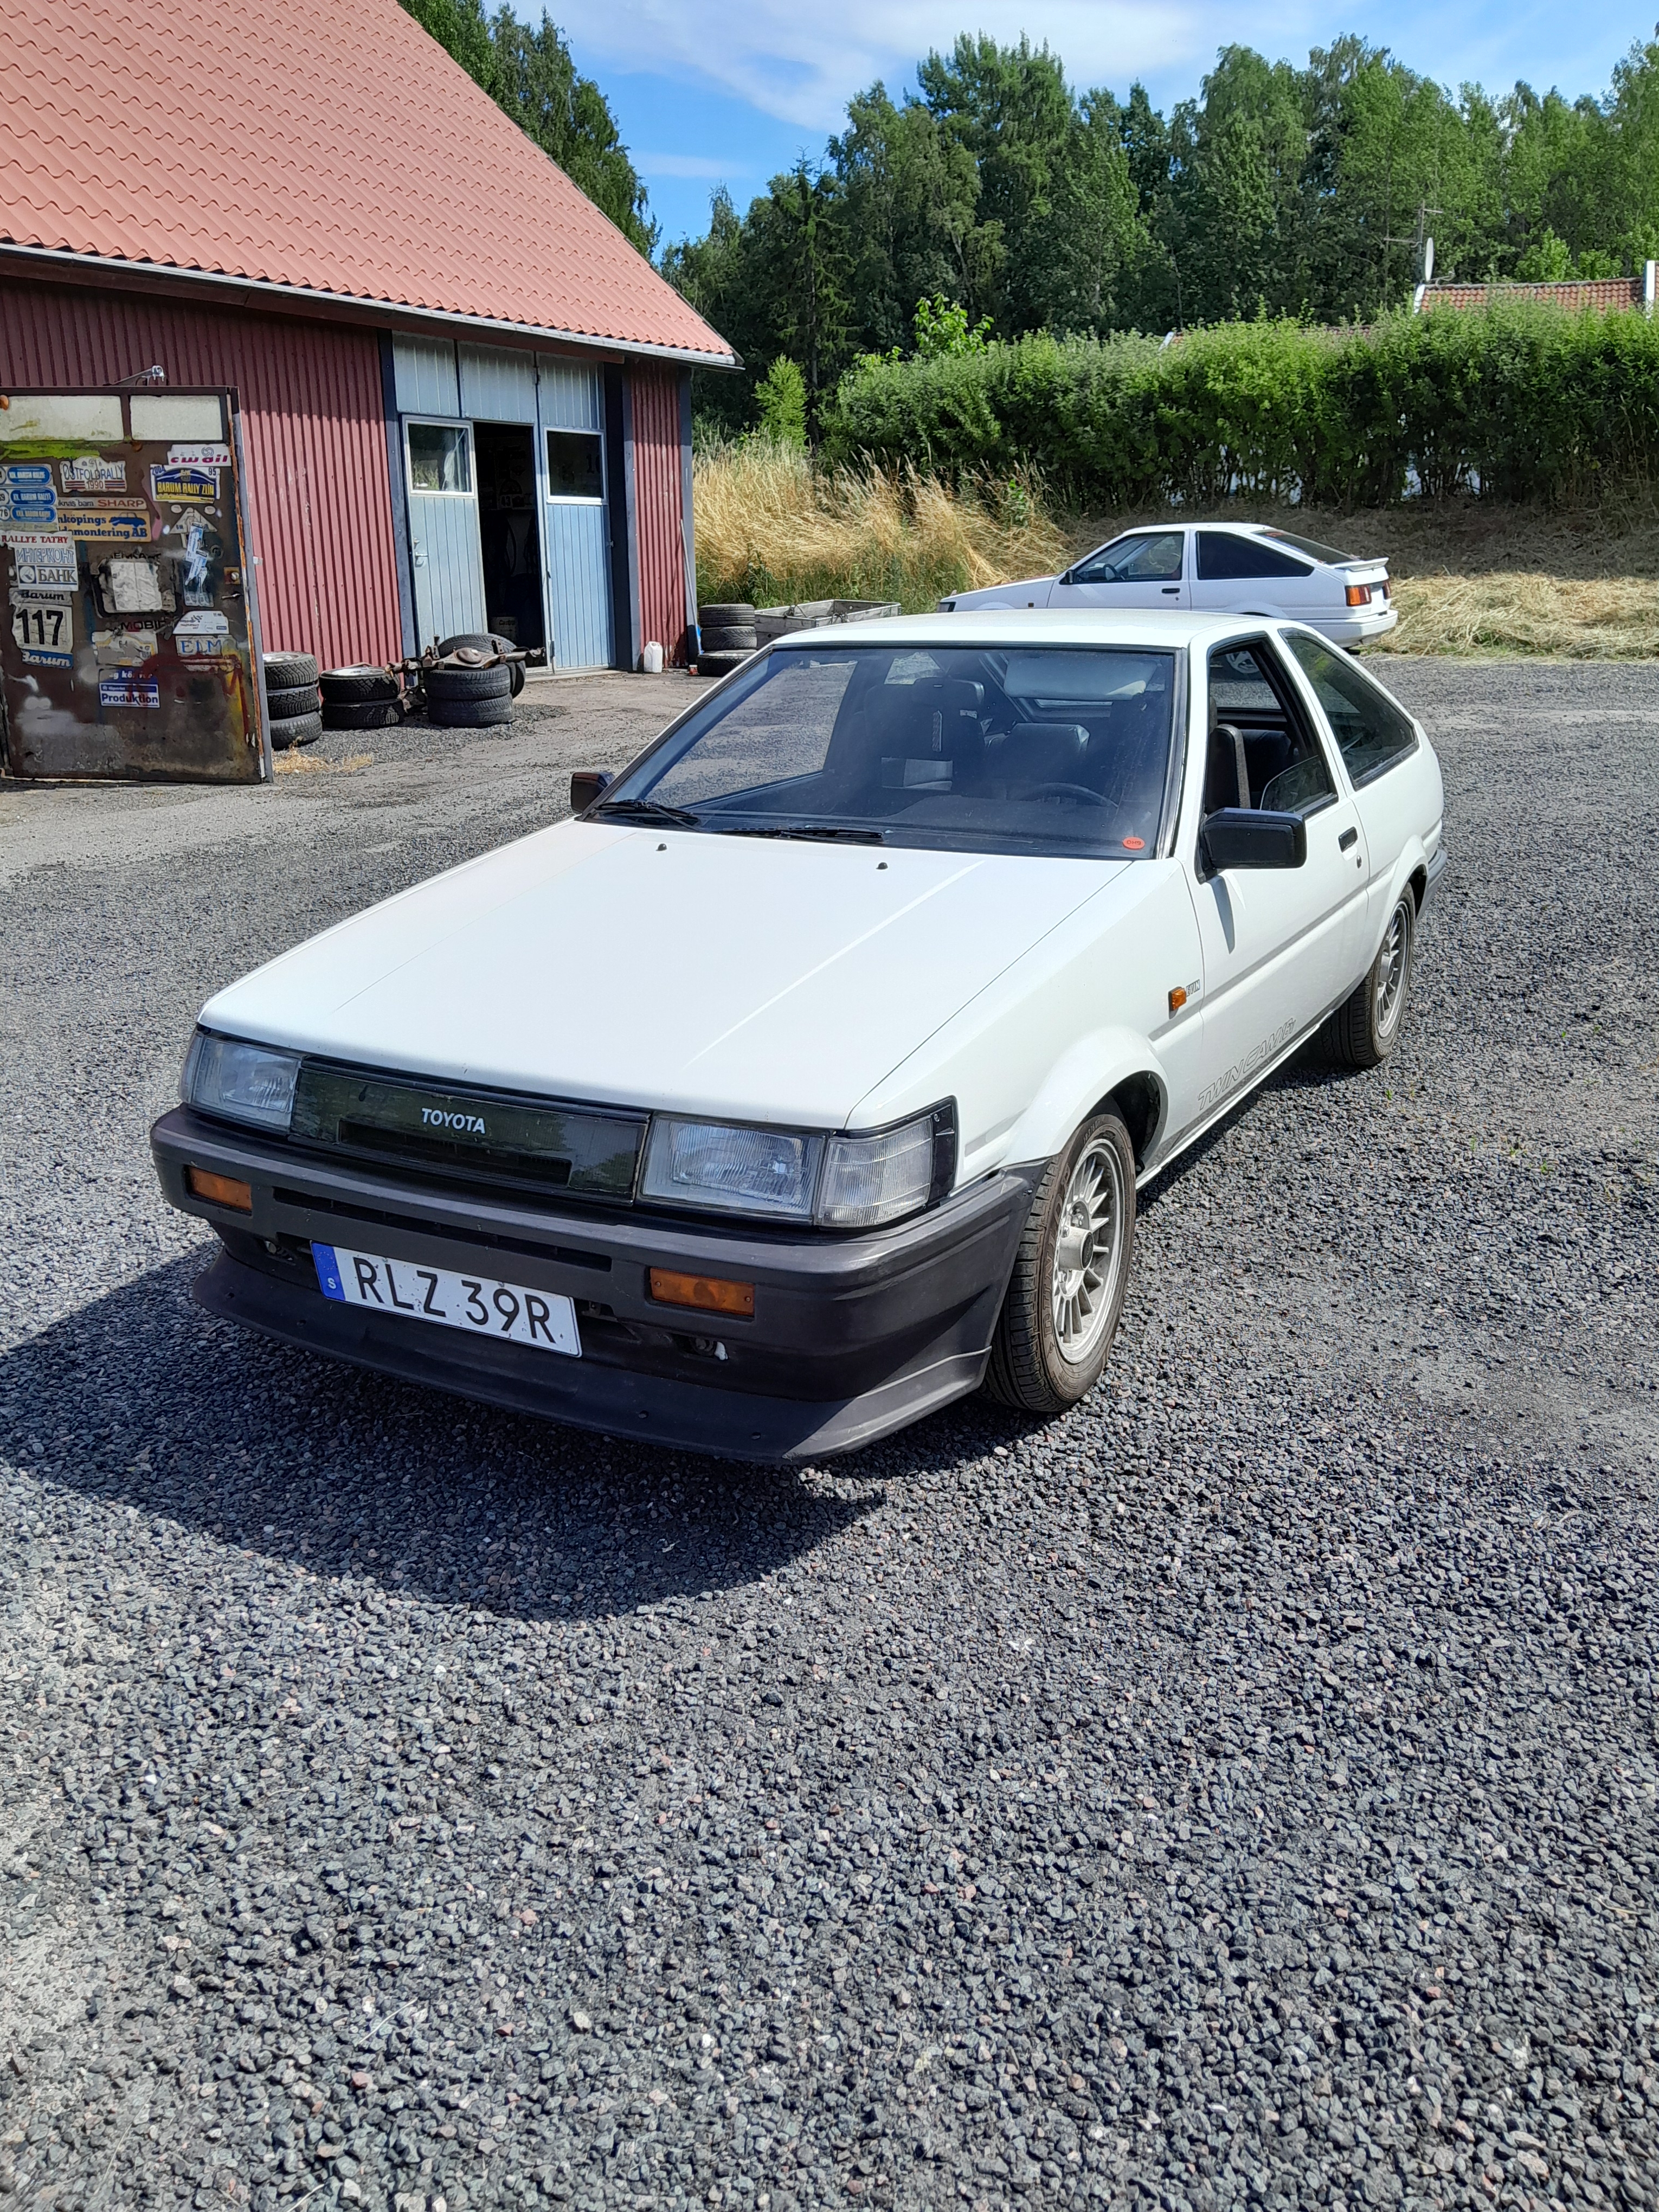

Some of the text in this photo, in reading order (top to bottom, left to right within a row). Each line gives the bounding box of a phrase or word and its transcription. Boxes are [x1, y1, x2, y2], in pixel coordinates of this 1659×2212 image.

[87, 480, 104, 488] 1990
[58, 513, 106, 525] nköpings
[131, 528, 147, 537] AB
[40, 536, 68, 544] TATRY
[37, 568, 77, 582] БАНК
[16, 608, 63, 646] 117
[101, 693, 158, 704] Produktion
[1186, 979, 1200, 997] EVIN
[422, 1108, 485, 1134] TOYOTA
[327, 1277, 337, 1289] S
[353, 1257, 556, 1344] RLZ 39R
